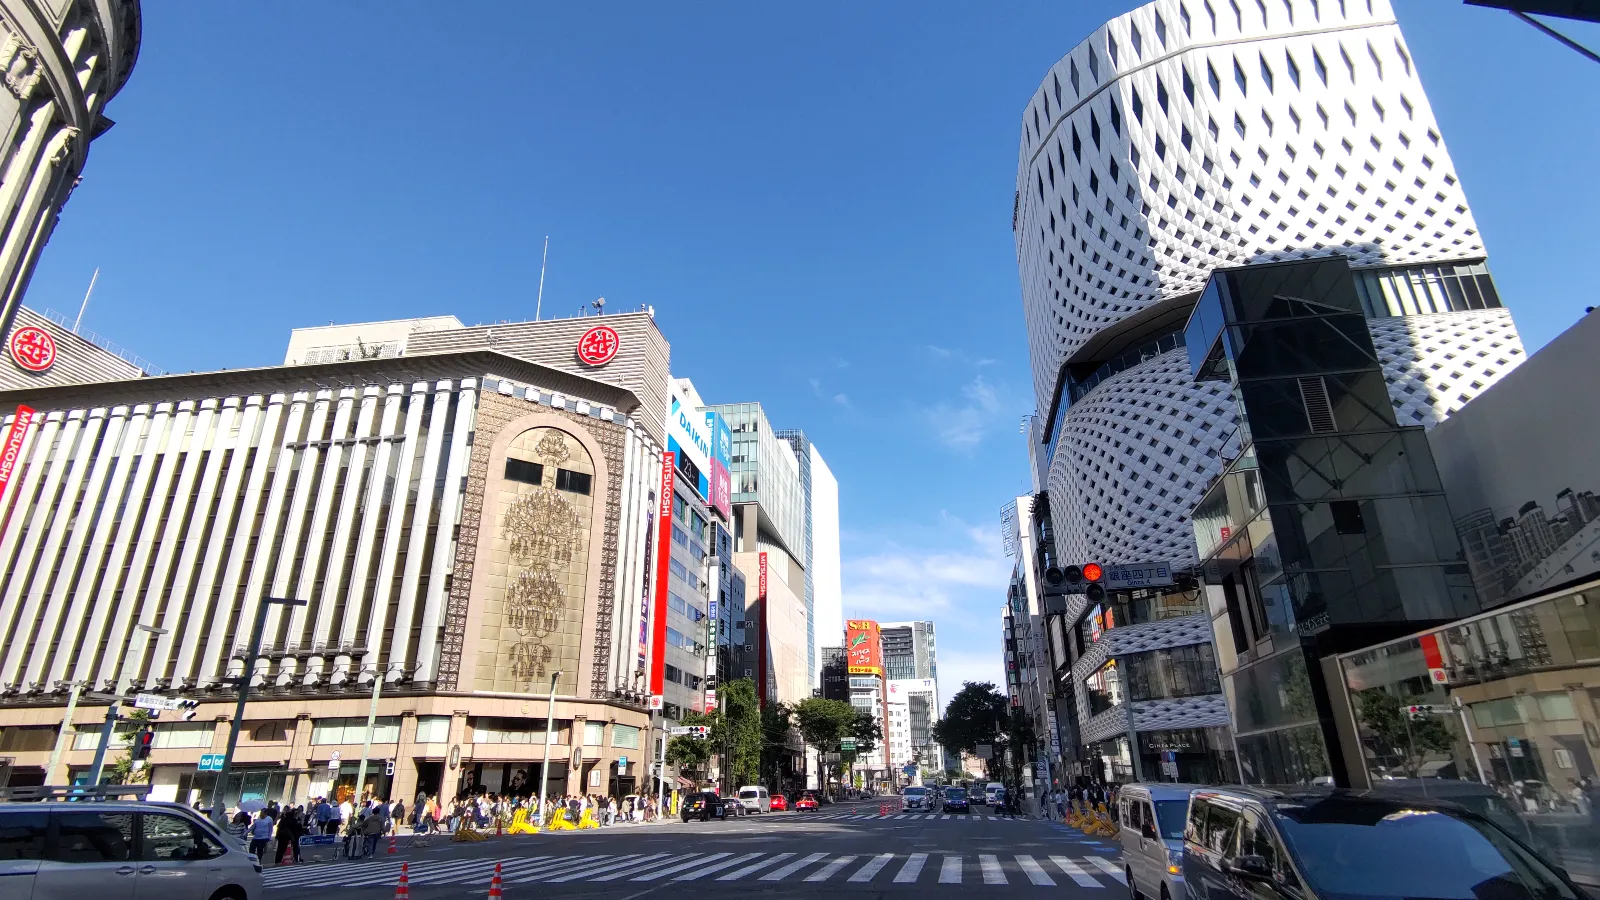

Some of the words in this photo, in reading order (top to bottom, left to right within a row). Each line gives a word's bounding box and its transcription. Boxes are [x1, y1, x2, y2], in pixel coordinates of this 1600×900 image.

[0, 411, 31, 483] MITSUKOSHI
[679, 411, 709, 459] DAIKIN
[684, 457, 692, 479] 23
[662, 456, 673, 517] MITSUKOSHI
[1108, 567, 1167, 581] 銀座四丁目
[851, 648, 871, 657] スパイス
